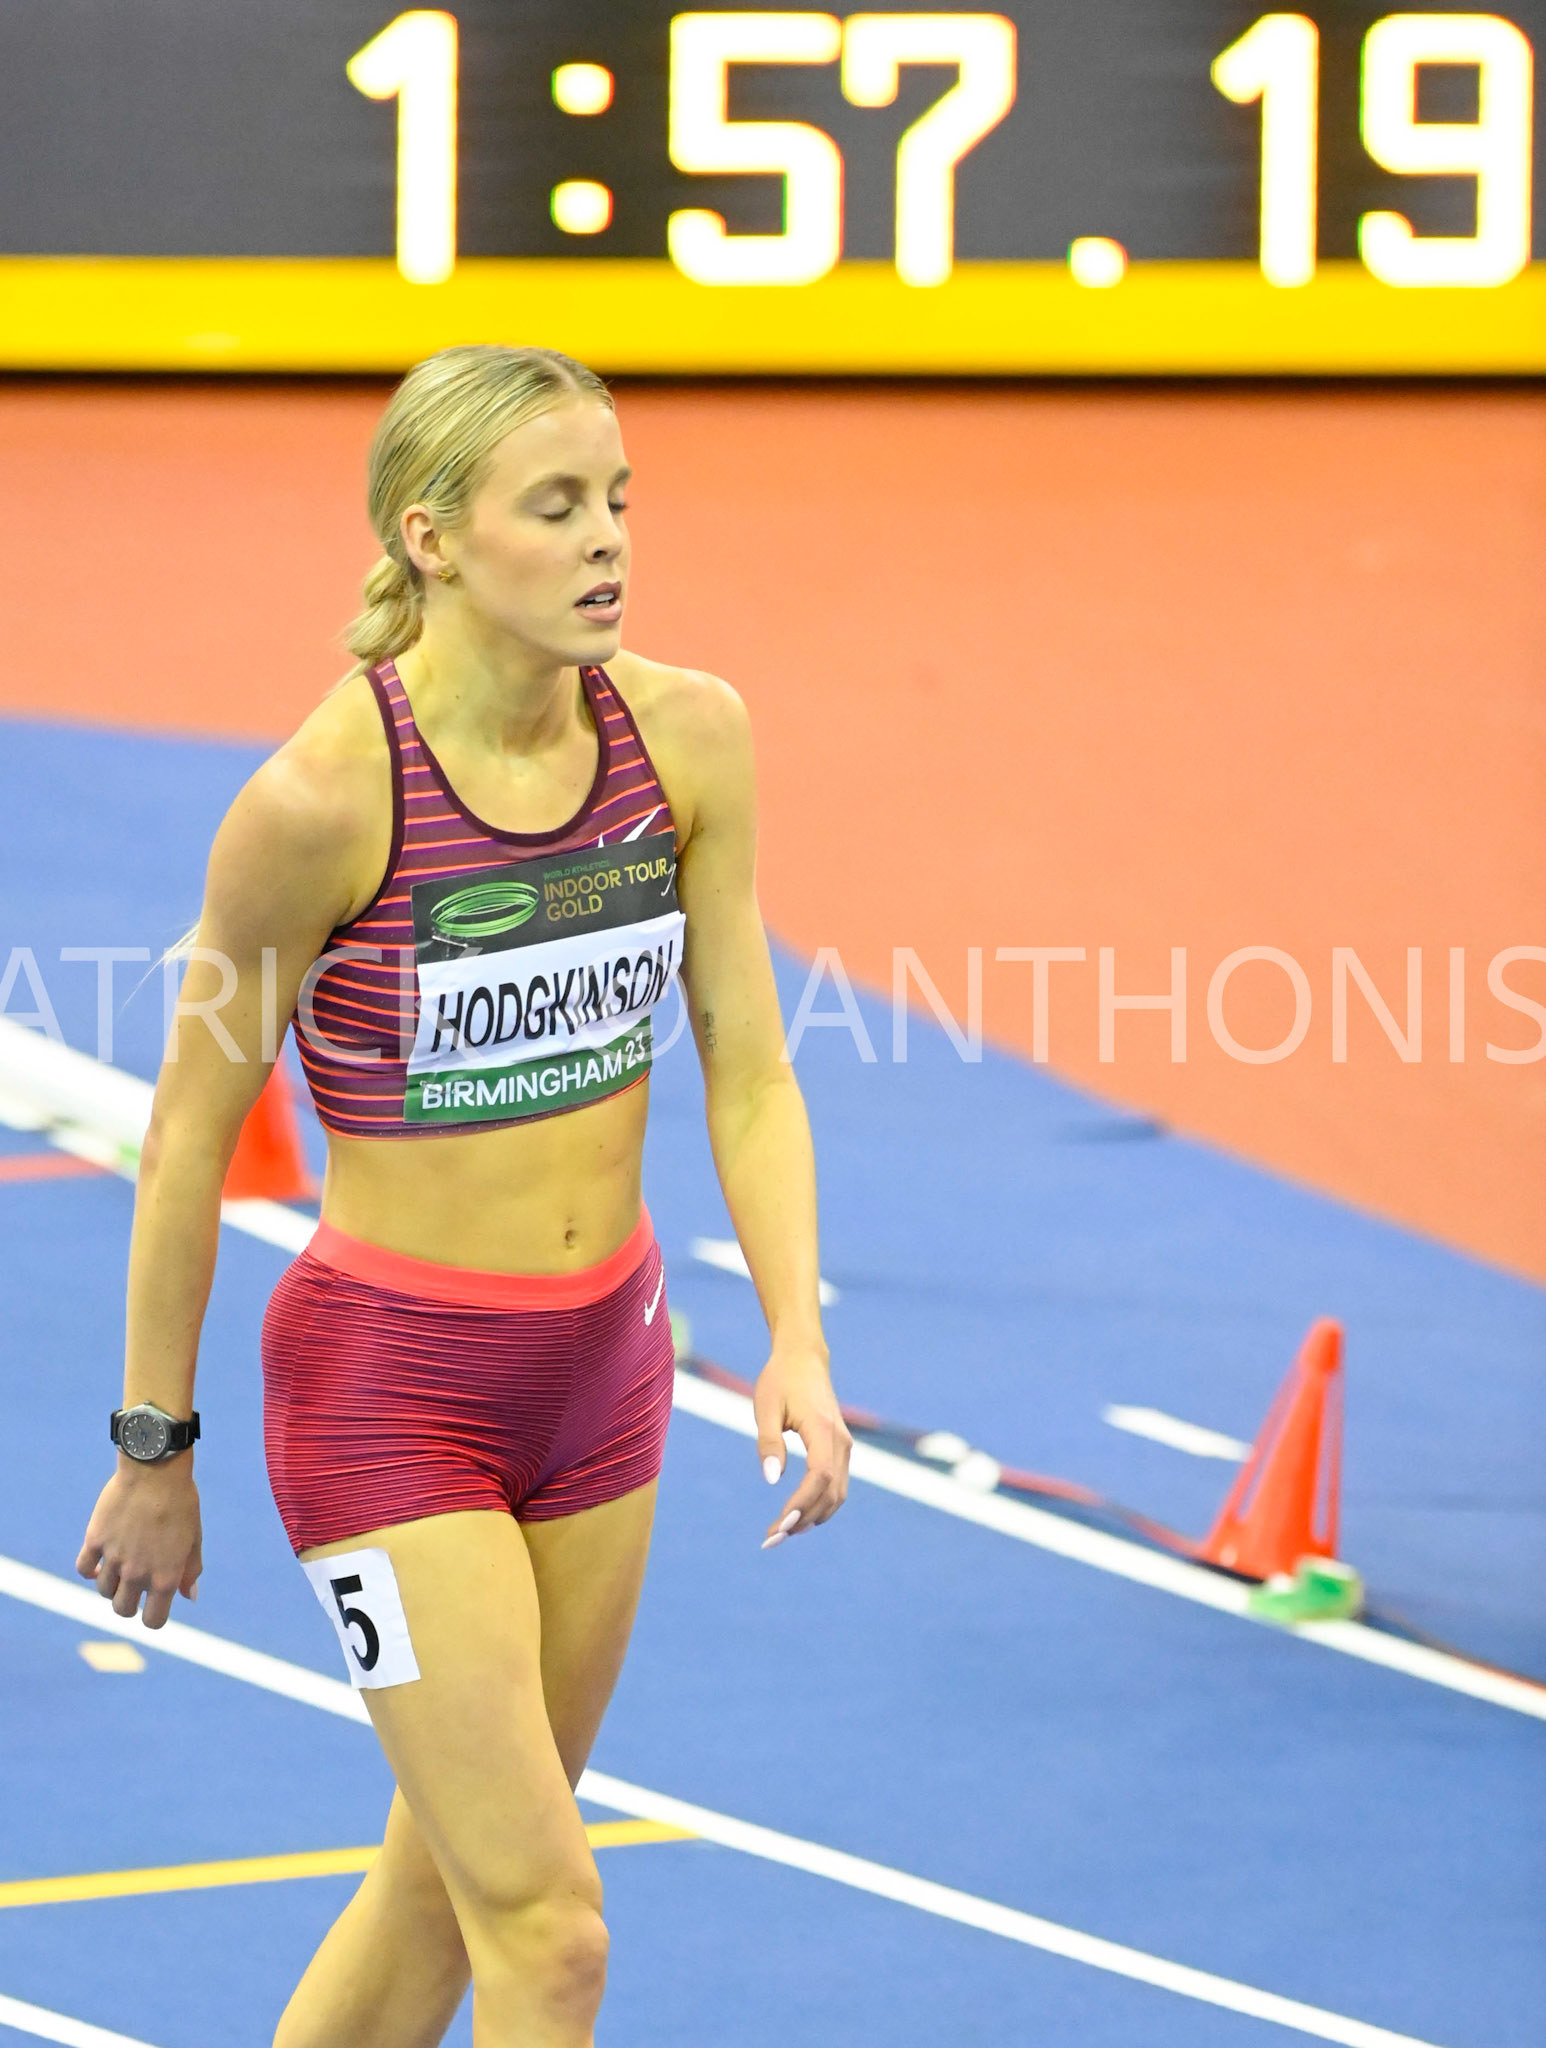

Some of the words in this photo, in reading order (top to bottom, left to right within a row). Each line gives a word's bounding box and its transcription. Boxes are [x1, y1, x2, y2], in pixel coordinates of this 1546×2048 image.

[544, 869, 622, 901] INDOOR
[624, 857, 668, 884] TOUR
[546, 894, 603, 922] GOLD
[431, 940, 674, 1053] HODGKINSON
[422, 1049, 622, 1109] BIRMINGHAM
[625, 1031, 646, 1070] 23
[330, 1574, 380, 1671] 5
